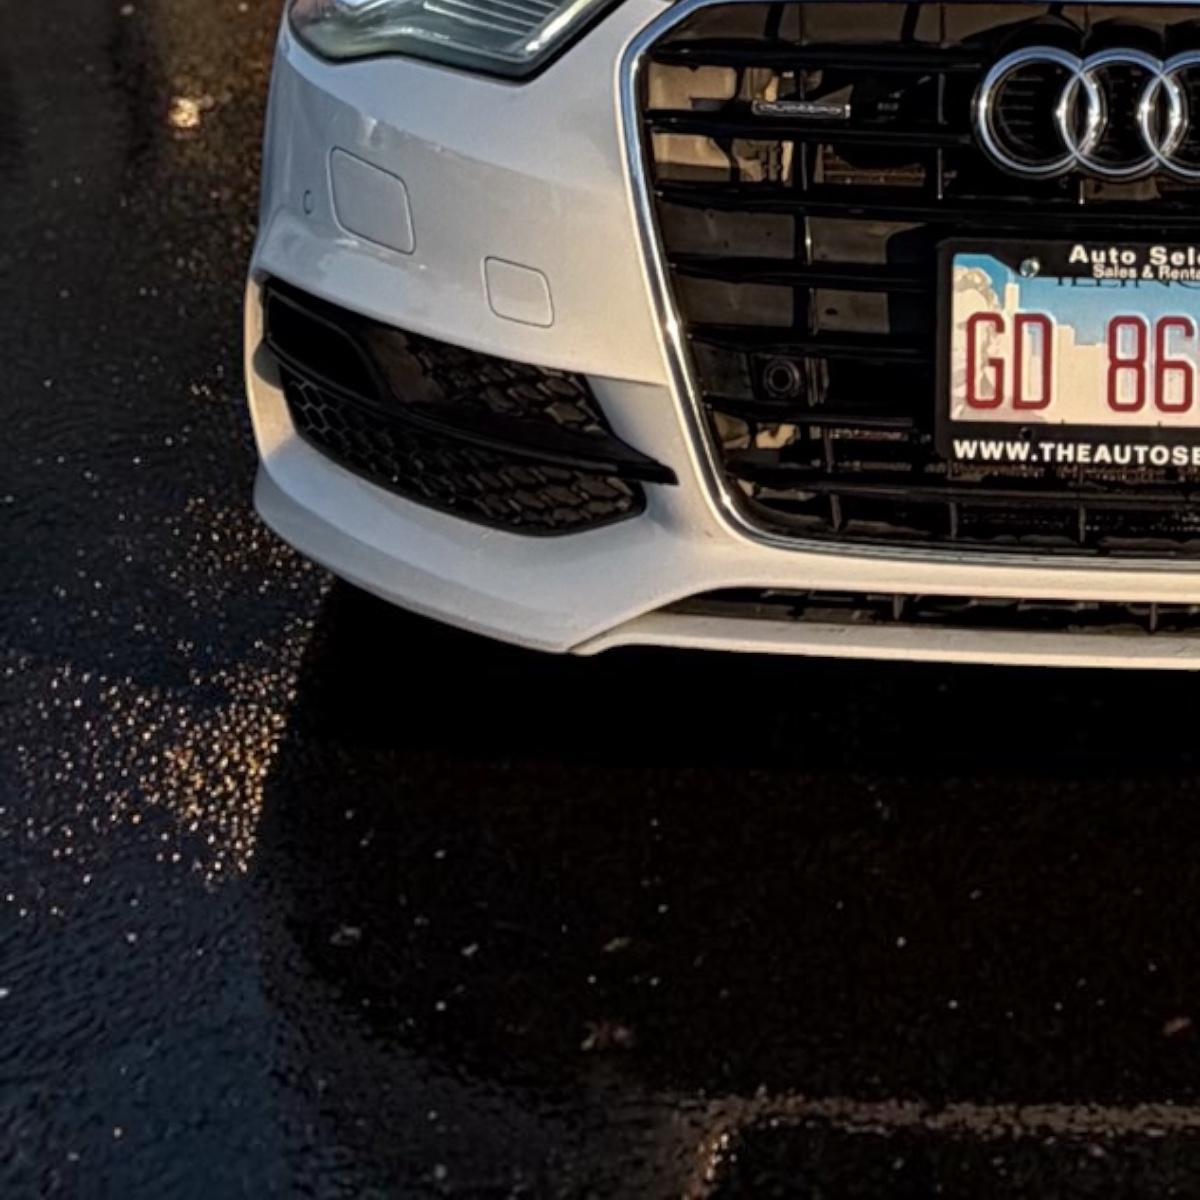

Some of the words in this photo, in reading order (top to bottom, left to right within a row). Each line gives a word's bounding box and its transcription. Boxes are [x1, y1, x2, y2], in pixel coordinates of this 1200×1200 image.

[1069, 245, 1136, 264] Auto
[1093, 264, 1136, 279] Sales
[1142, 265, 1153, 279] &
[966, 312, 1052, 410] GD
